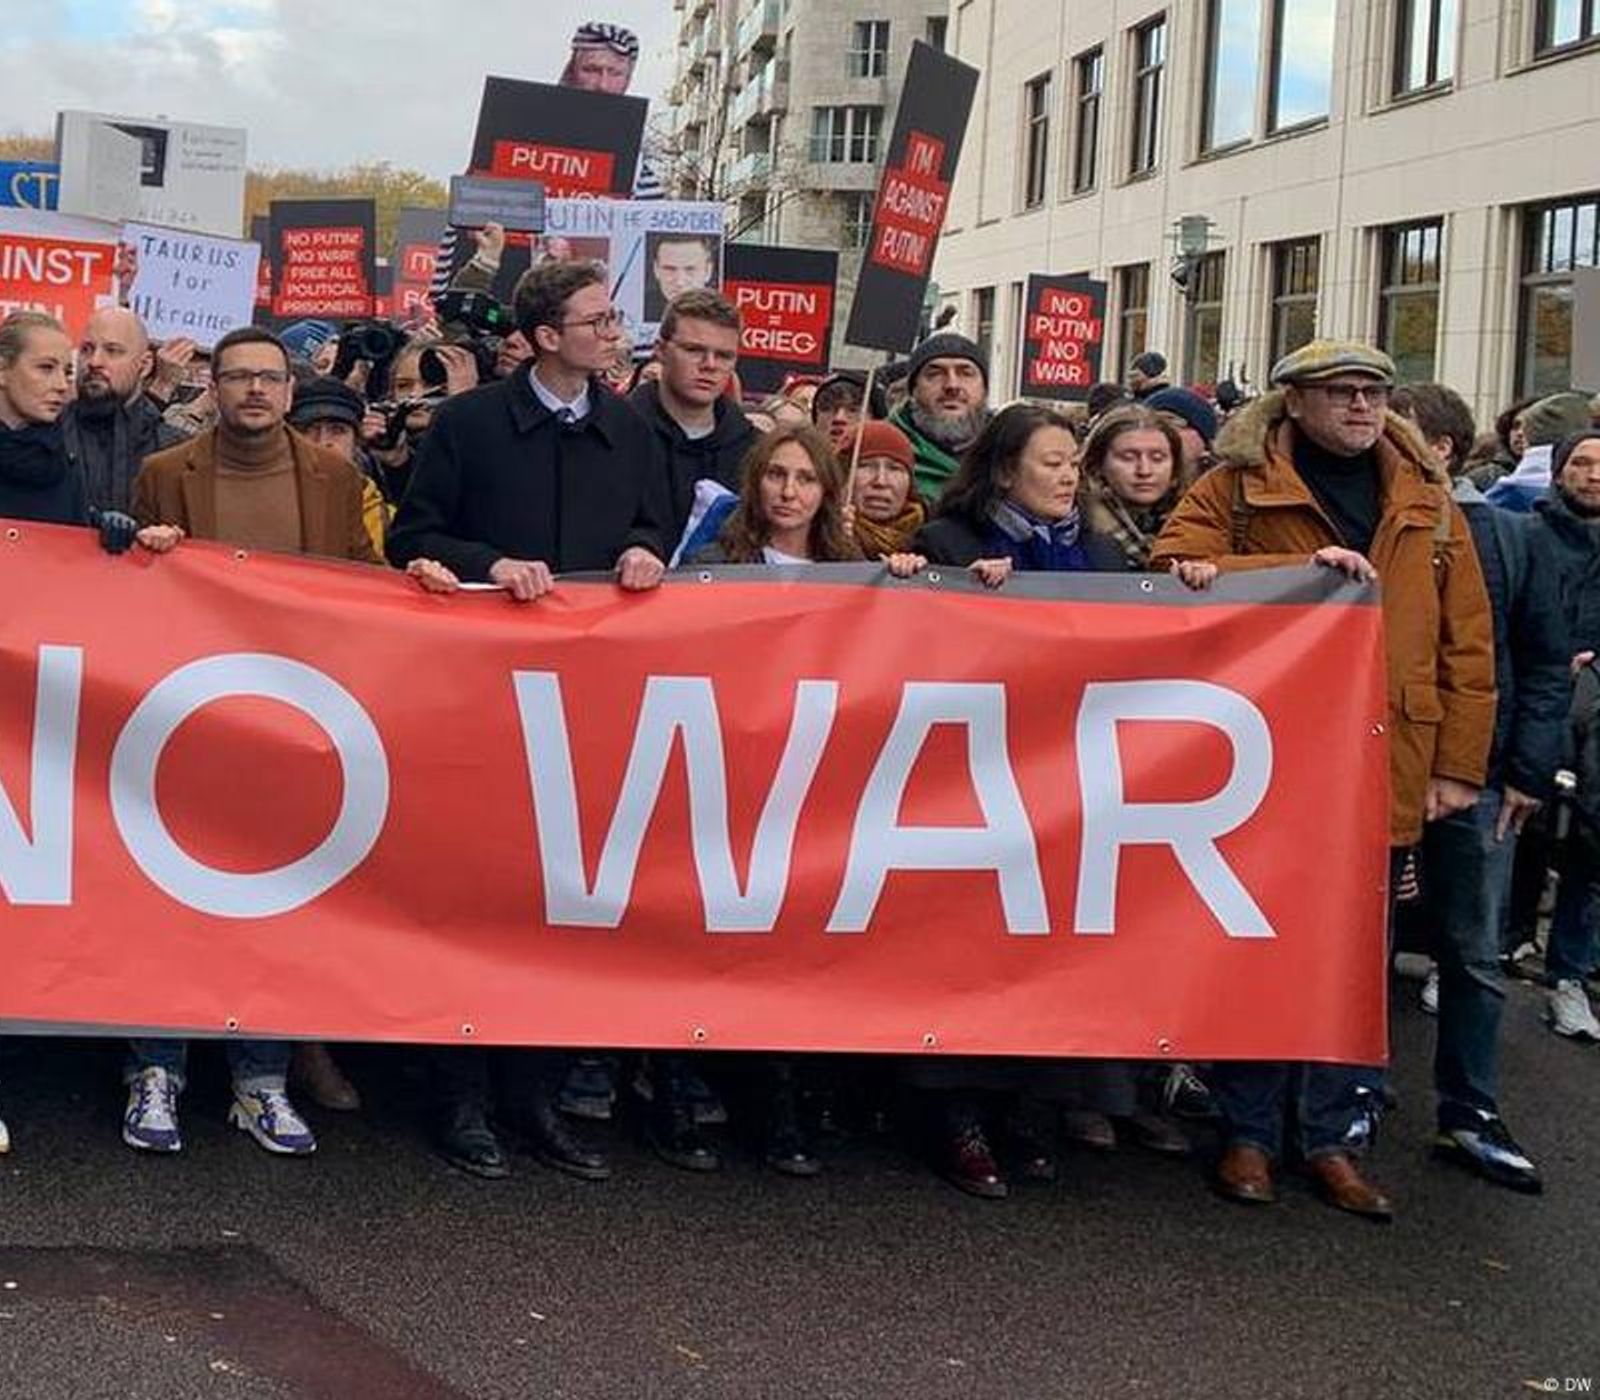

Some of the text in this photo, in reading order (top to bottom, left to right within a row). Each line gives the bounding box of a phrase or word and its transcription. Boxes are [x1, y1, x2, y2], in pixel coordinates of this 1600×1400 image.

[511, 147, 591, 178] PUTIN
[883, 178, 945, 225] AGAINST
[544, 202, 615, 231] UTIN
[287, 230, 310, 247] NO
[289, 248, 315, 264] NO
[291, 265, 358, 280] FREE ALL
[287, 282, 360, 298] POLITICAL
[737, 287, 817, 315] PUTIN
[1050, 295, 1083, 317] NO
[1035, 315, 1094, 341] PUTIN
[1046, 340, 1080, 361] NO
[1035, 360, 1082, 382] WAR
[512, 669, 1278, 938] WAR
